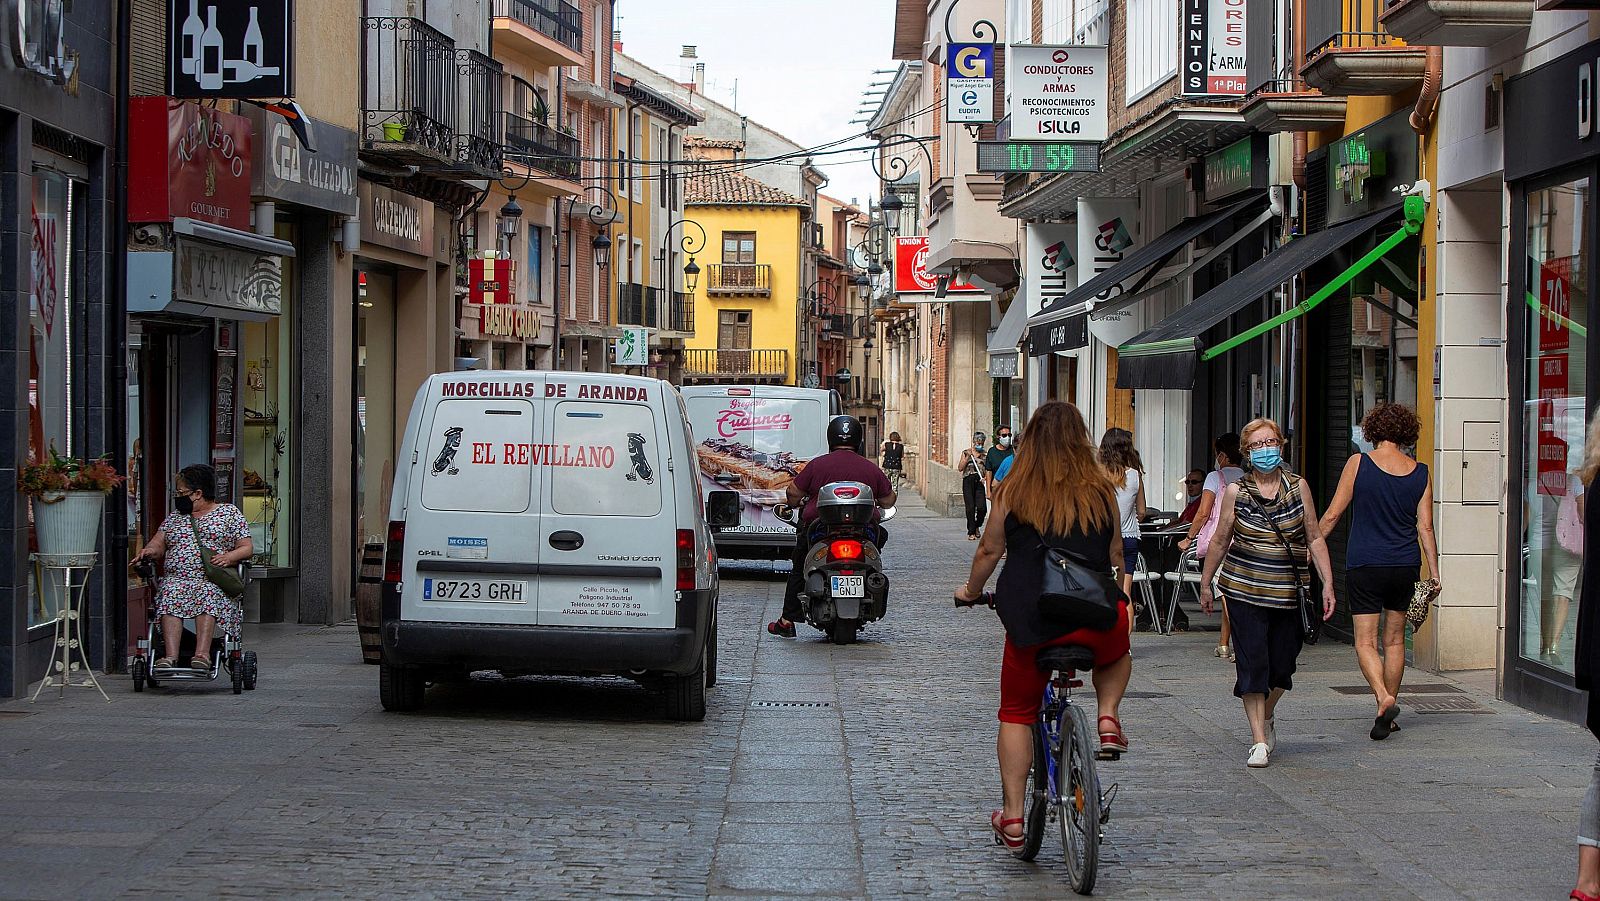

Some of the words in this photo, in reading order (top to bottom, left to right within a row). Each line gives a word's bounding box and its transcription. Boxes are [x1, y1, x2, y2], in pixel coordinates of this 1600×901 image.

[955, 47, 986, 78] G
[1023, 65, 1094, 75] CONDUCTORES
[1042, 84, 1076, 93] ARMAS
[1022, 98, 1096, 107] RECONOCIMIENTOS
[1030, 107, 1090, 116] PSICOTECNICOS
[1038, 119, 1081, 134] ISILLA
[178, 117, 243, 177] RENEDO
[1005, 144, 1032, 170] 10
[1046, 144, 1074, 170] 59
[308, 158, 353, 196] CALZADOS
[190, 201, 231, 219] GOURMET
[374, 196, 421, 242] CALZEDONIA
[899, 237, 922, 246] UNIÓN
[197, 252, 248, 302] RENE
[485, 305, 513, 337] BASILIO
[515, 309, 542, 338] CRIADO
[442, 382, 534, 398] MORCILLAS
[545, 383, 567, 398] DE
[578, 384, 648, 402] ARANDA
[472, 442, 496, 465] EL
[503, 443, 615, 469] REVILLANO
[449, 538, 487, 546] MOISES
[436, 581, 481, 599] 8723
[488, 582, 523, 600] GRH
[838, 577, 862, 587] 2150
[839, 586, 857, 596] GNJ
